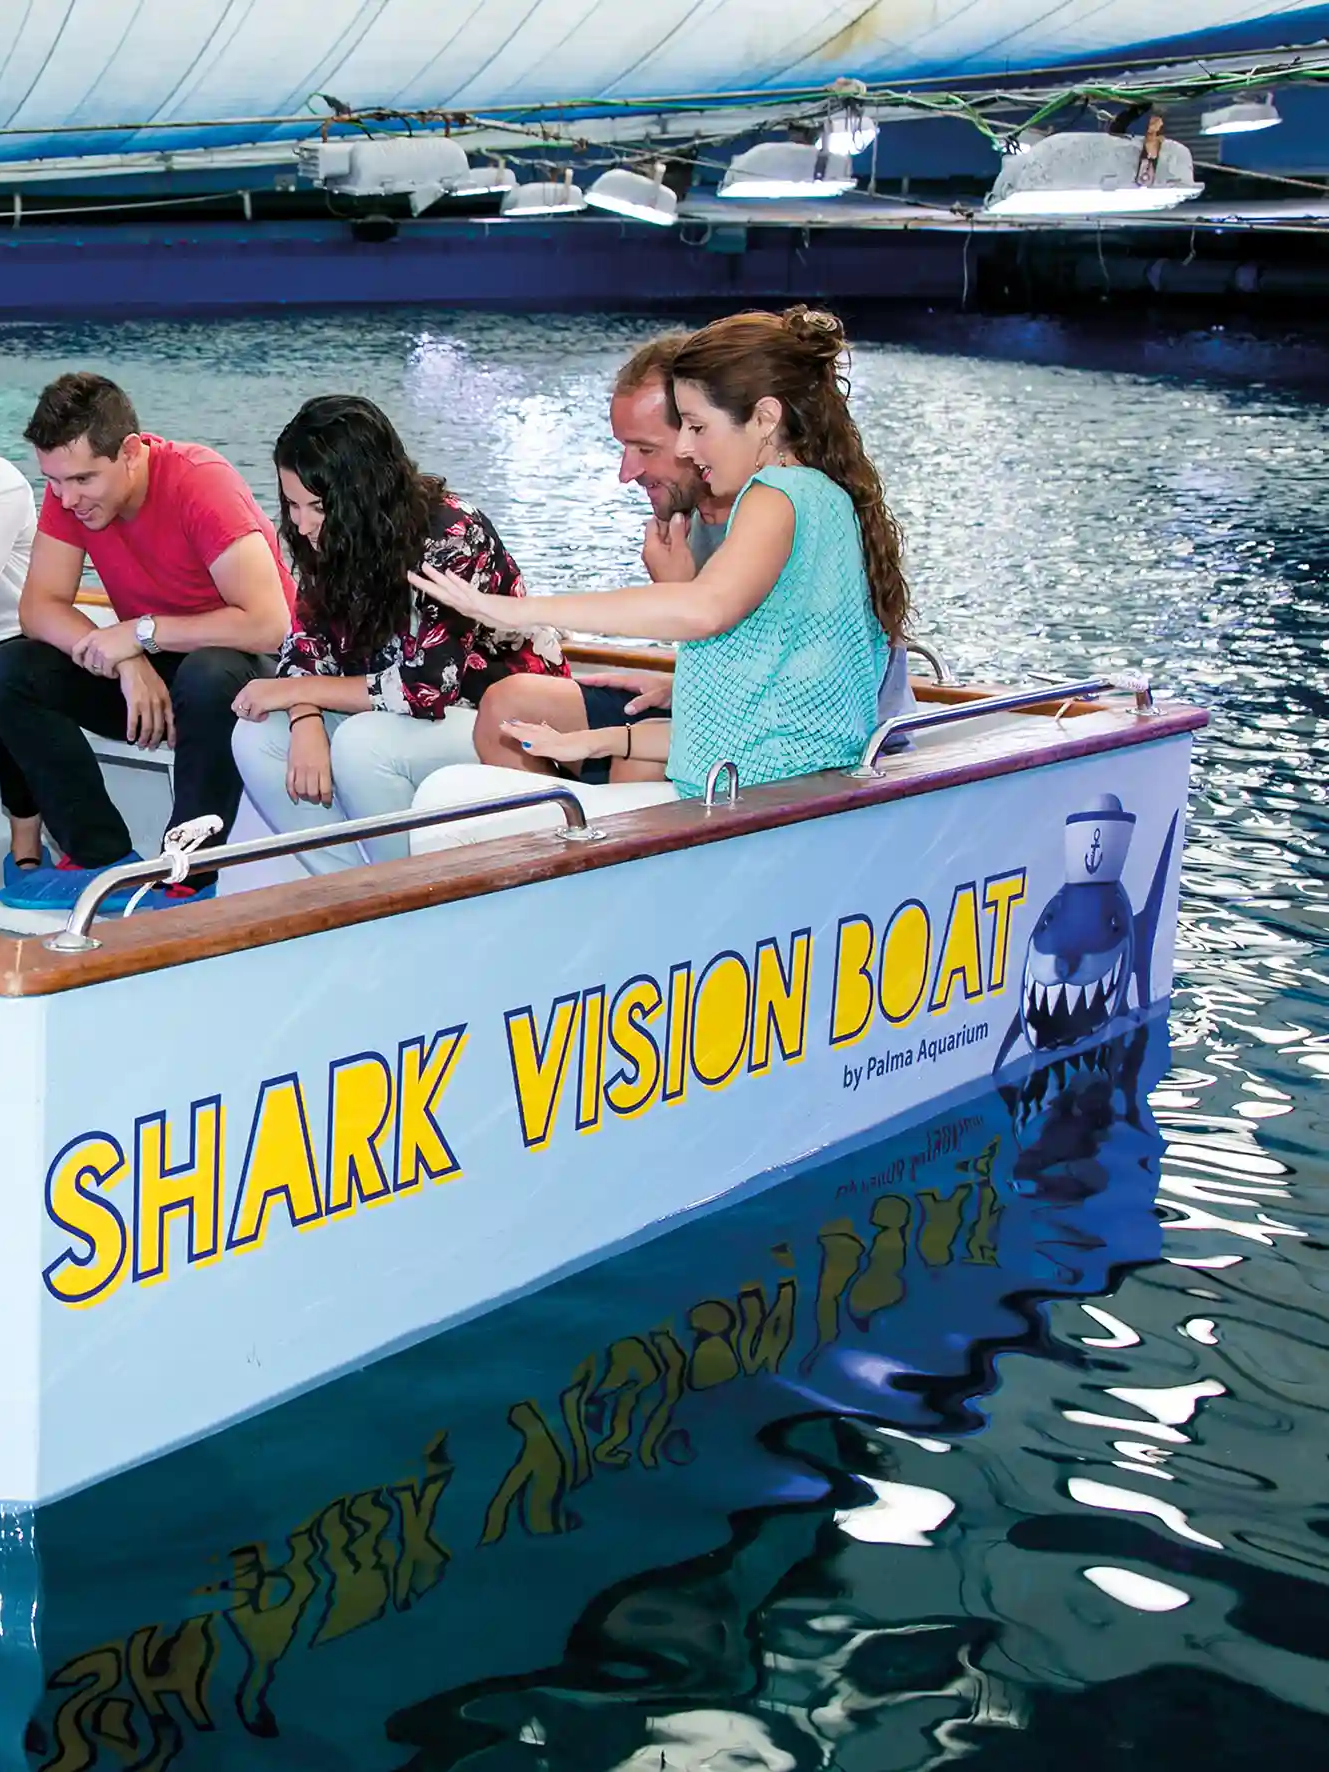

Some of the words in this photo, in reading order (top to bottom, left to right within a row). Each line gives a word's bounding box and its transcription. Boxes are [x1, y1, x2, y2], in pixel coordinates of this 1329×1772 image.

[42, 1023, 470, 1309] SHARK
[504, 927, 813, 1152] VISION
[829, 867, 1027, 1050] BOAT
[843, 1064, 863, 1091] by
[867, 1049, 913, 1080] Palma
[916, 1022, 989, 1062] Aquarium
